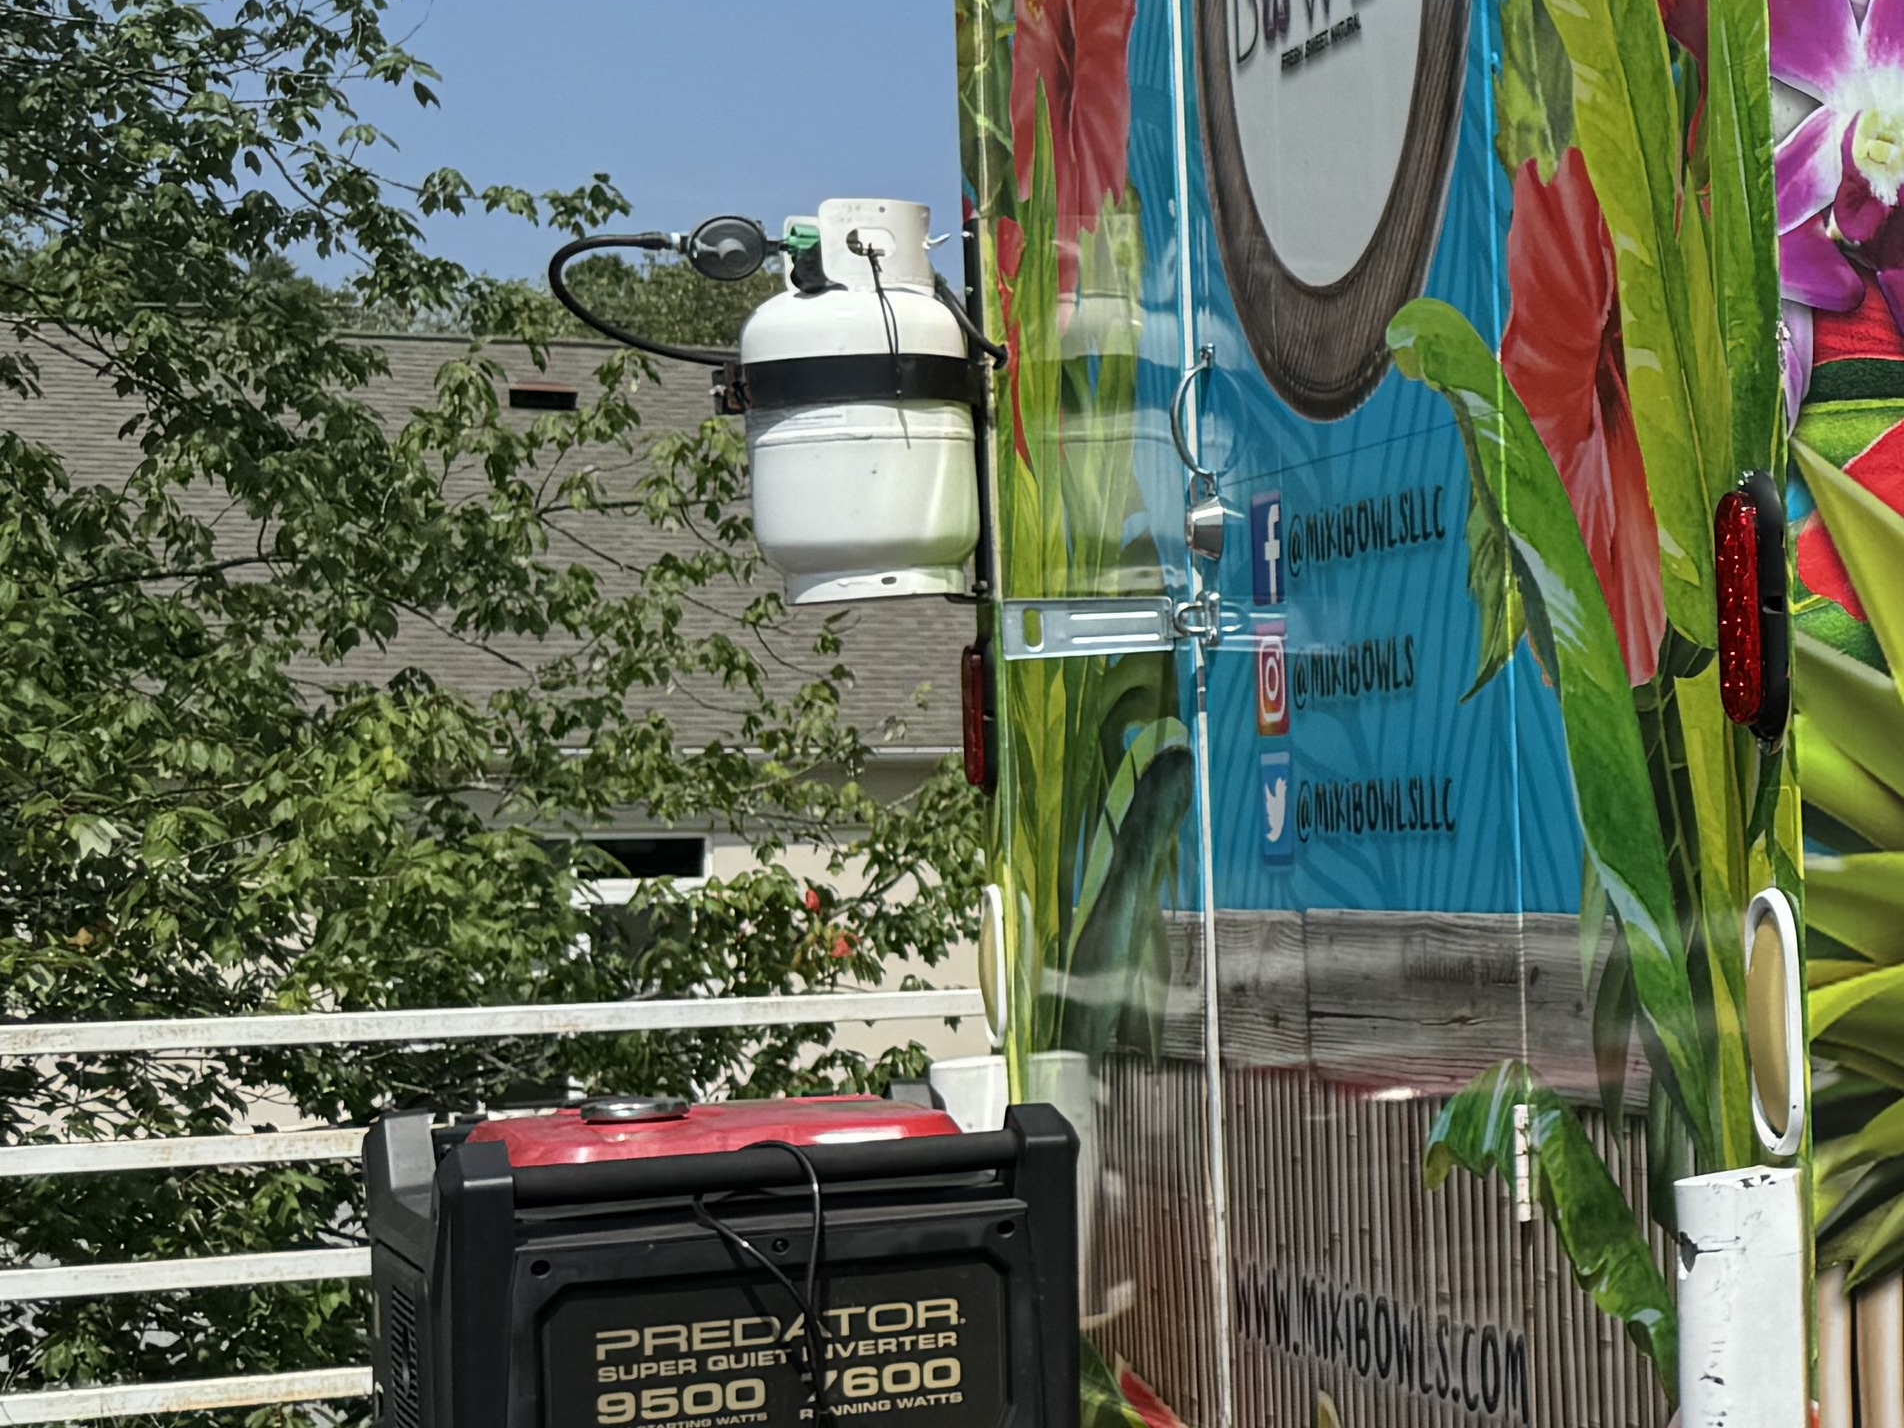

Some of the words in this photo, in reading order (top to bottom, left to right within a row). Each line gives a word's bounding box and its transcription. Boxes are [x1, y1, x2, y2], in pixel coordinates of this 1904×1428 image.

[597, 1357, 698, 1383] SUPER
[706, 1348, 792, 1373] QUIET
[597, 1377, 767, 1425] 9500
[799, 1399, 892, 1421] RNNING
[896, 1391, 964, 1410] WATTS
[716, 1412, 768, 1427] WATTS
